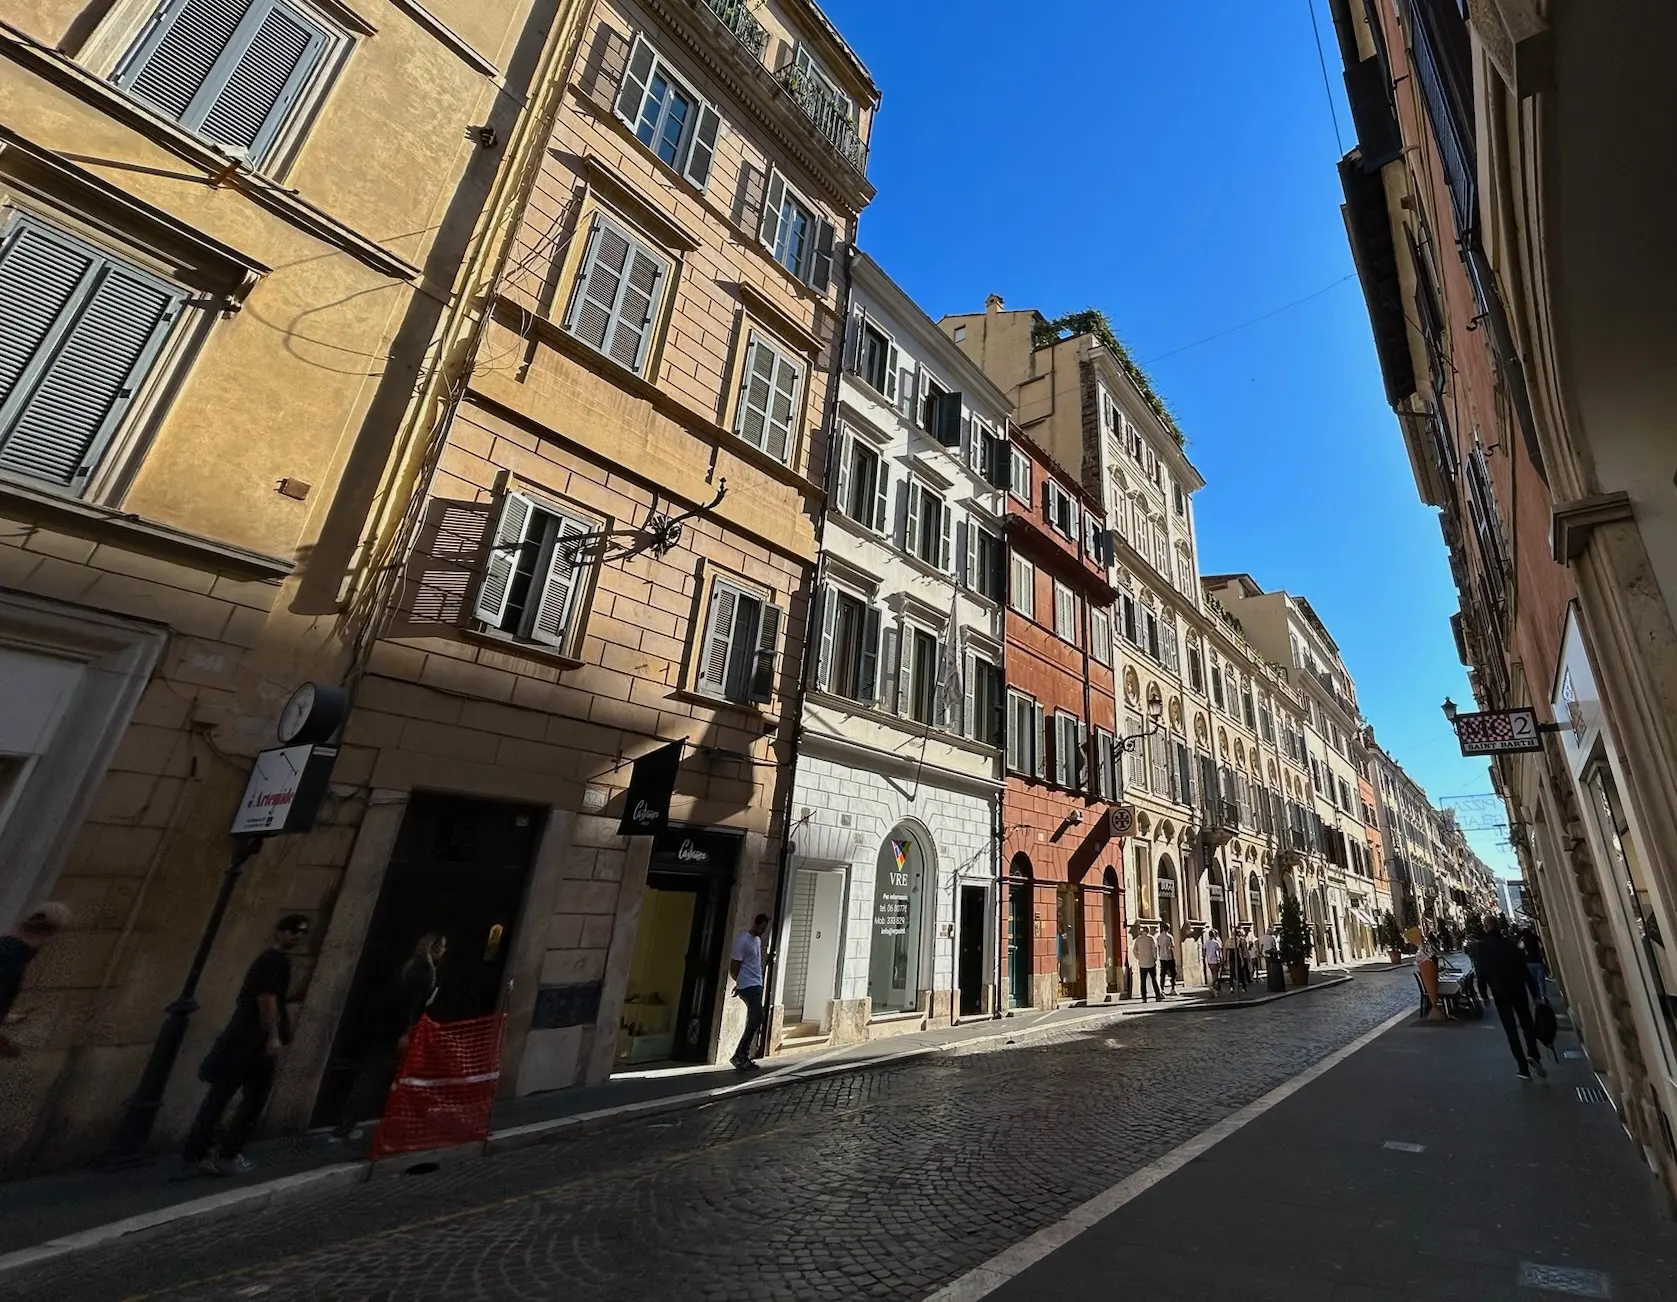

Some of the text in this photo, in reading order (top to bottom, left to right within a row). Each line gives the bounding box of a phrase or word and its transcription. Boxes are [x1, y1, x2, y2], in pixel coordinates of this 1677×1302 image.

[1500, 739, 1535, 748] BARTH
[256, 788, 294, 808] Artemide
[889, 872, 908, 886] VRE
[887, 904, 894, 912] 06
[886, 916, 896, 925] 333
